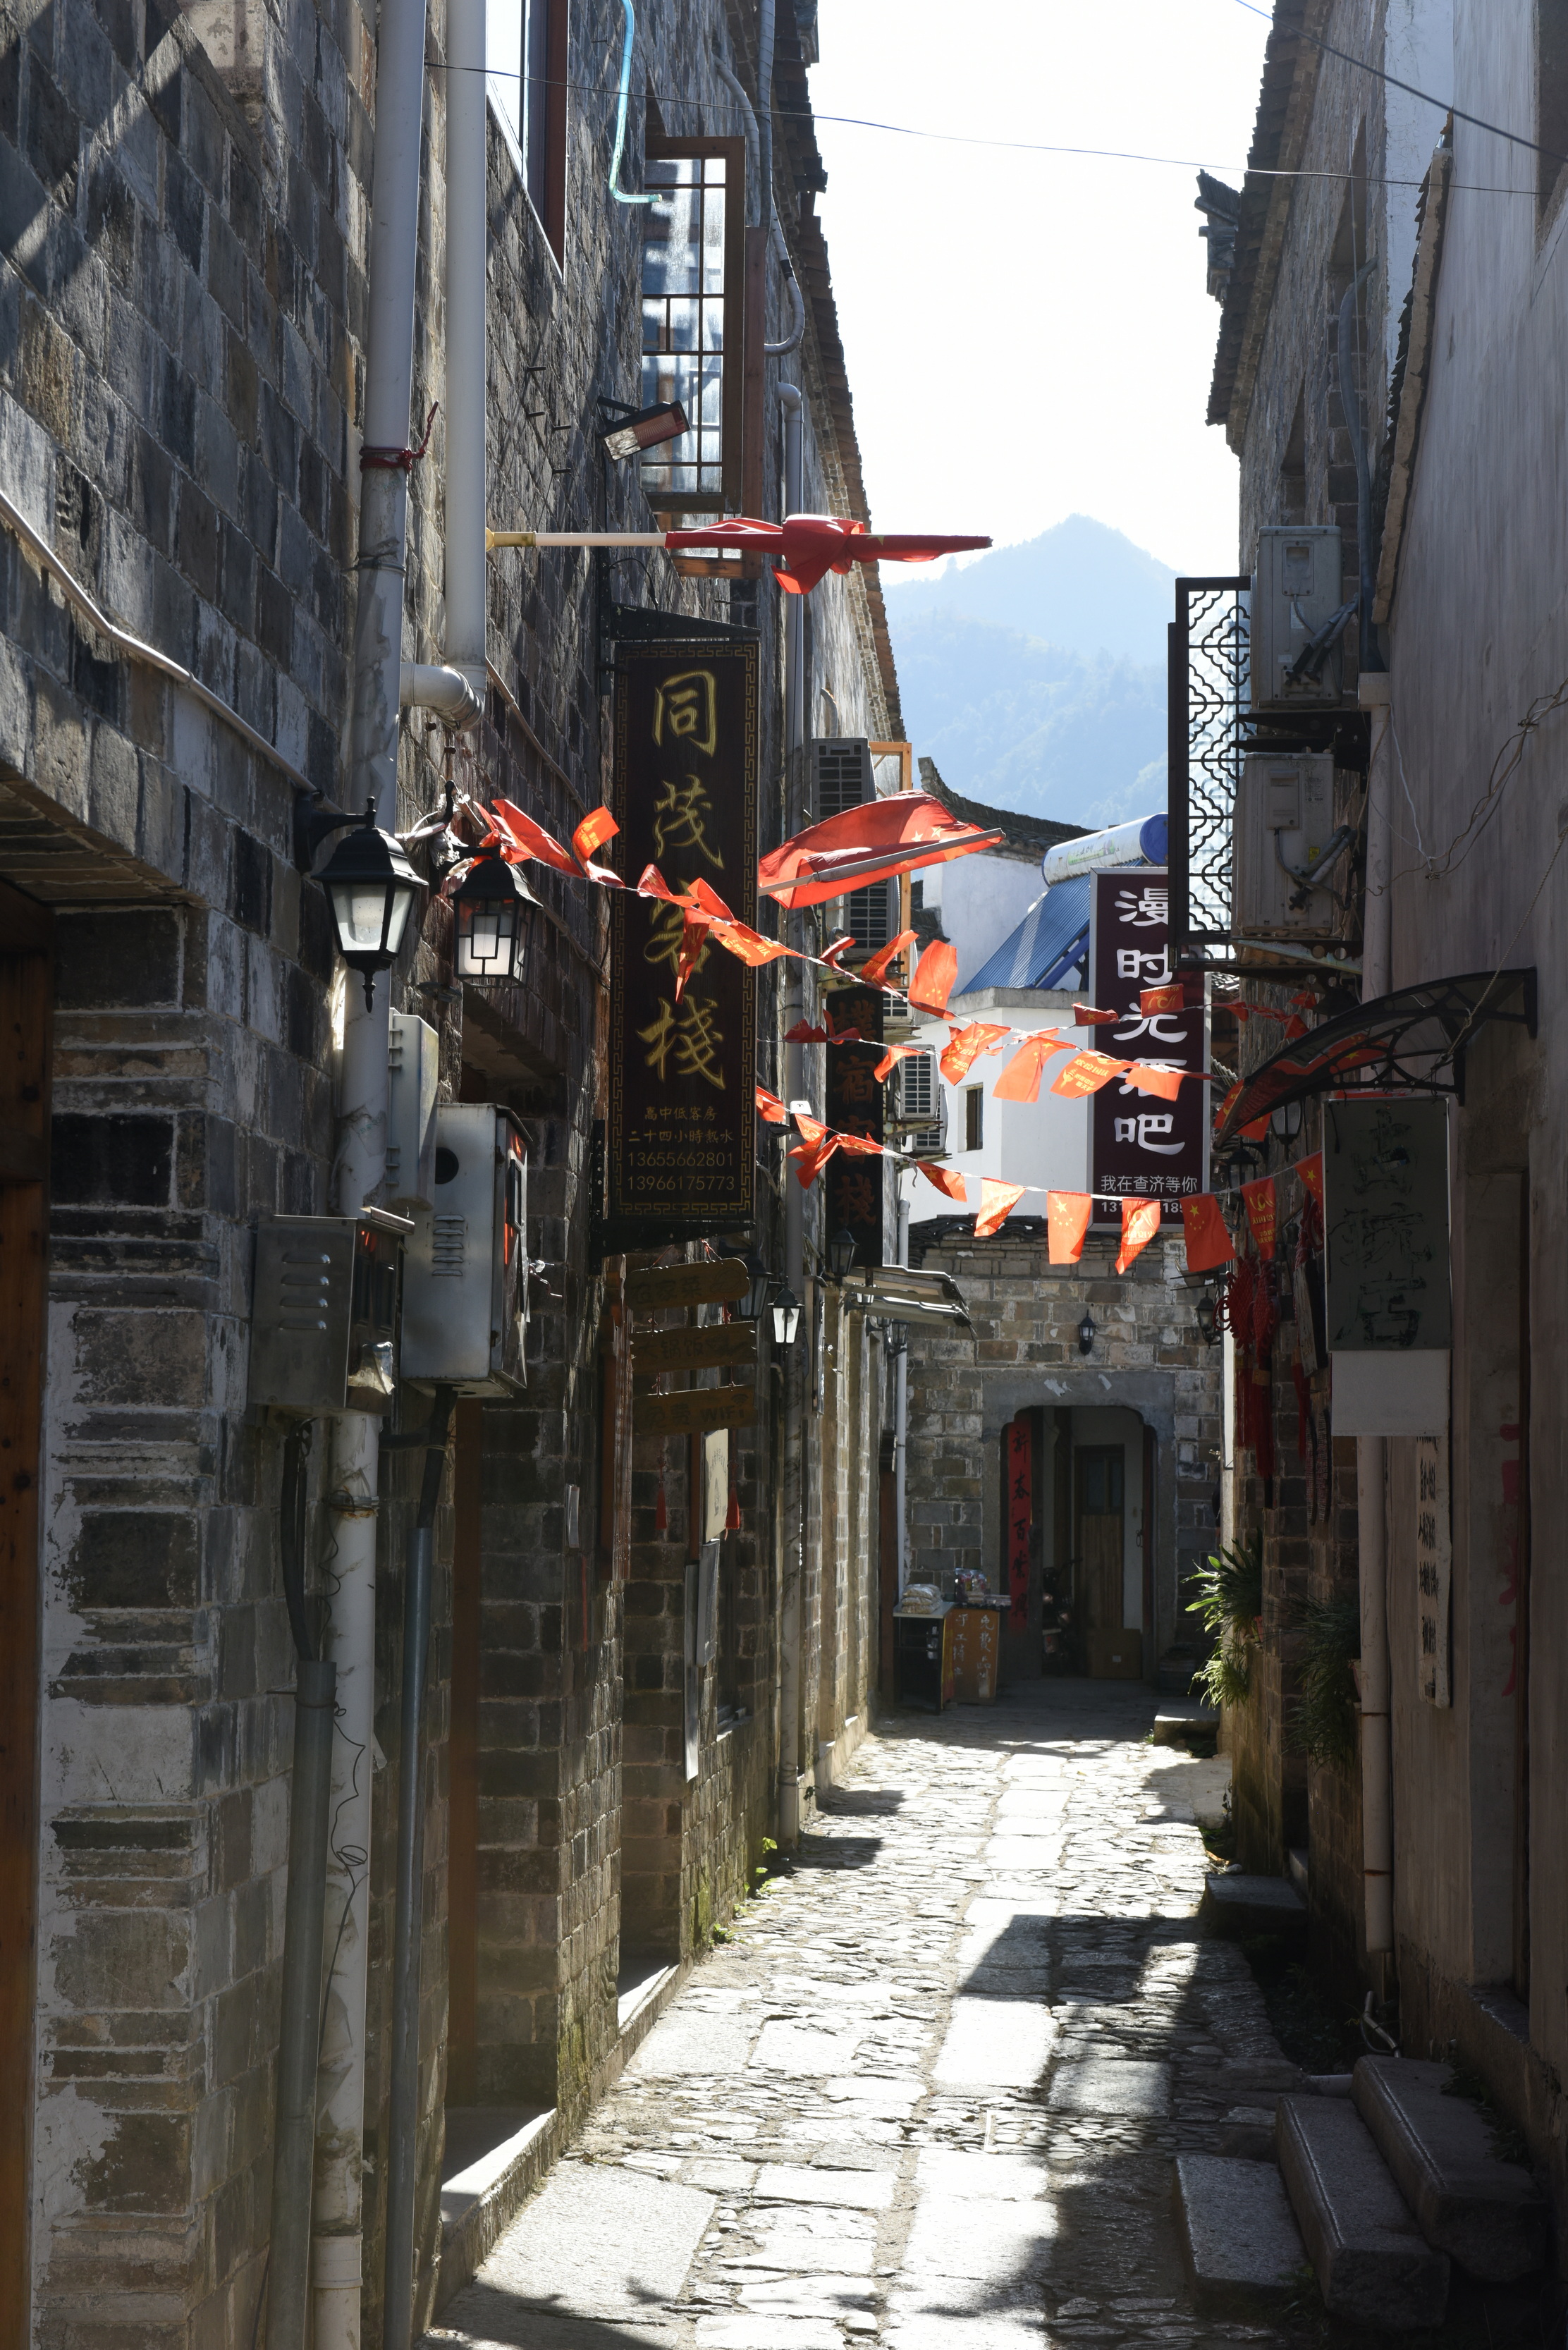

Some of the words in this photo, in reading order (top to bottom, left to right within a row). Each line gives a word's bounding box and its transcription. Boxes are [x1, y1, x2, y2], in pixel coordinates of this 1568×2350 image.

[644, 1106, 718, 1121] 高中低客房
[628, 1151, 733, 1166] 13655662801
[628, 1175, 735, 1191] 13966175773
[1101, 1175, 1198, 1193] 我在查济等你
